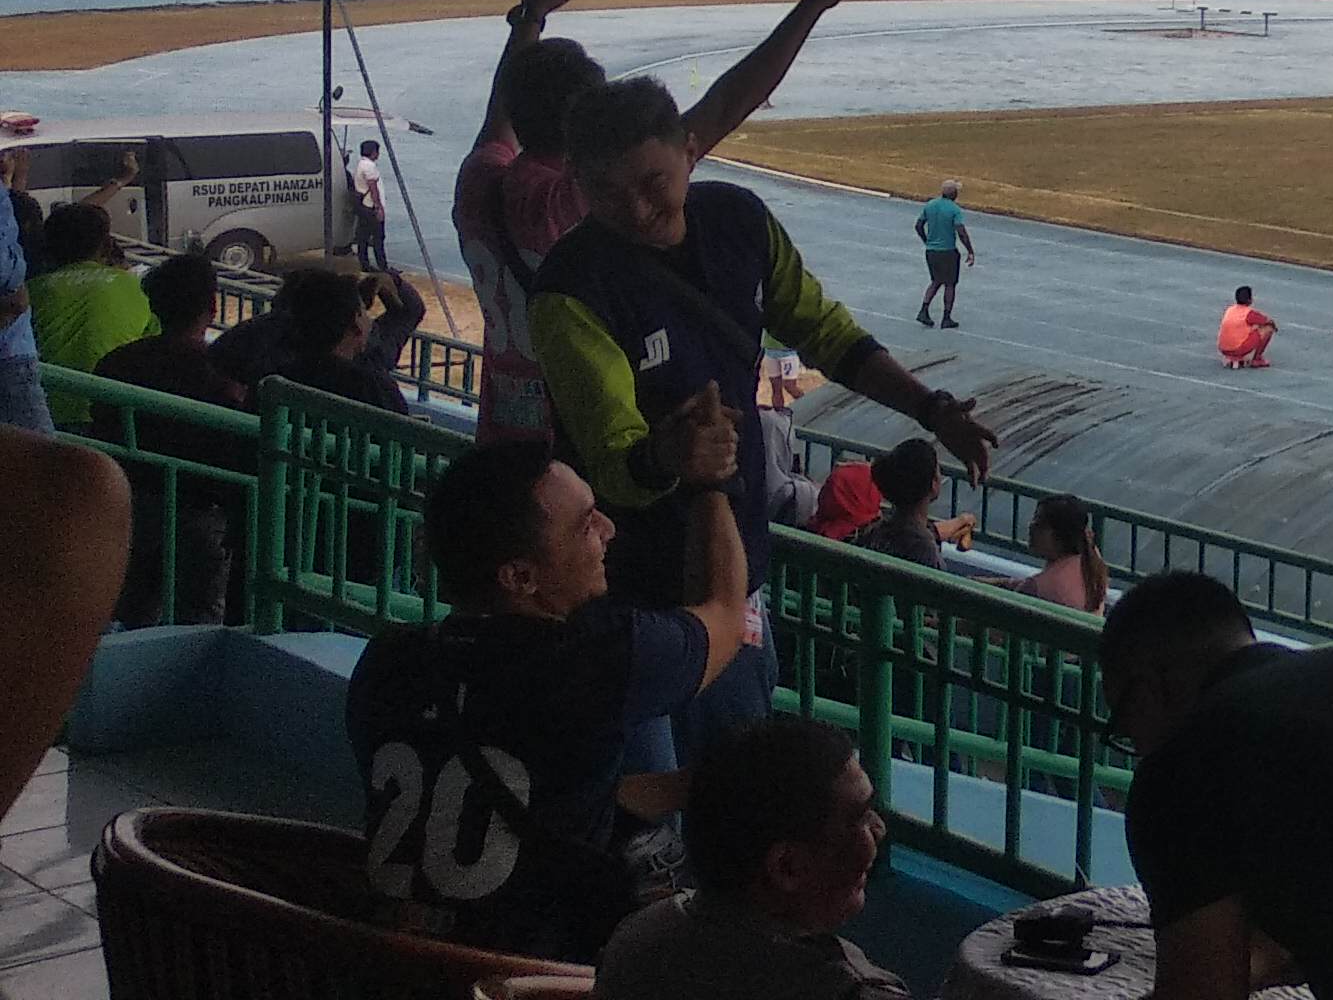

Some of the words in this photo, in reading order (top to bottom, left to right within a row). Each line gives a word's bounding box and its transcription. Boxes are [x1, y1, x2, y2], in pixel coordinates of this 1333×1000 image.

[192, 183, 225, 197] RSUD
[229, 180, 269, 194] DEPATI
[273, 178, 323, 192] HAMZAH
[208, 190, 309, 208] PANGKALPINANG
[367, 742, 531, 900] 20
